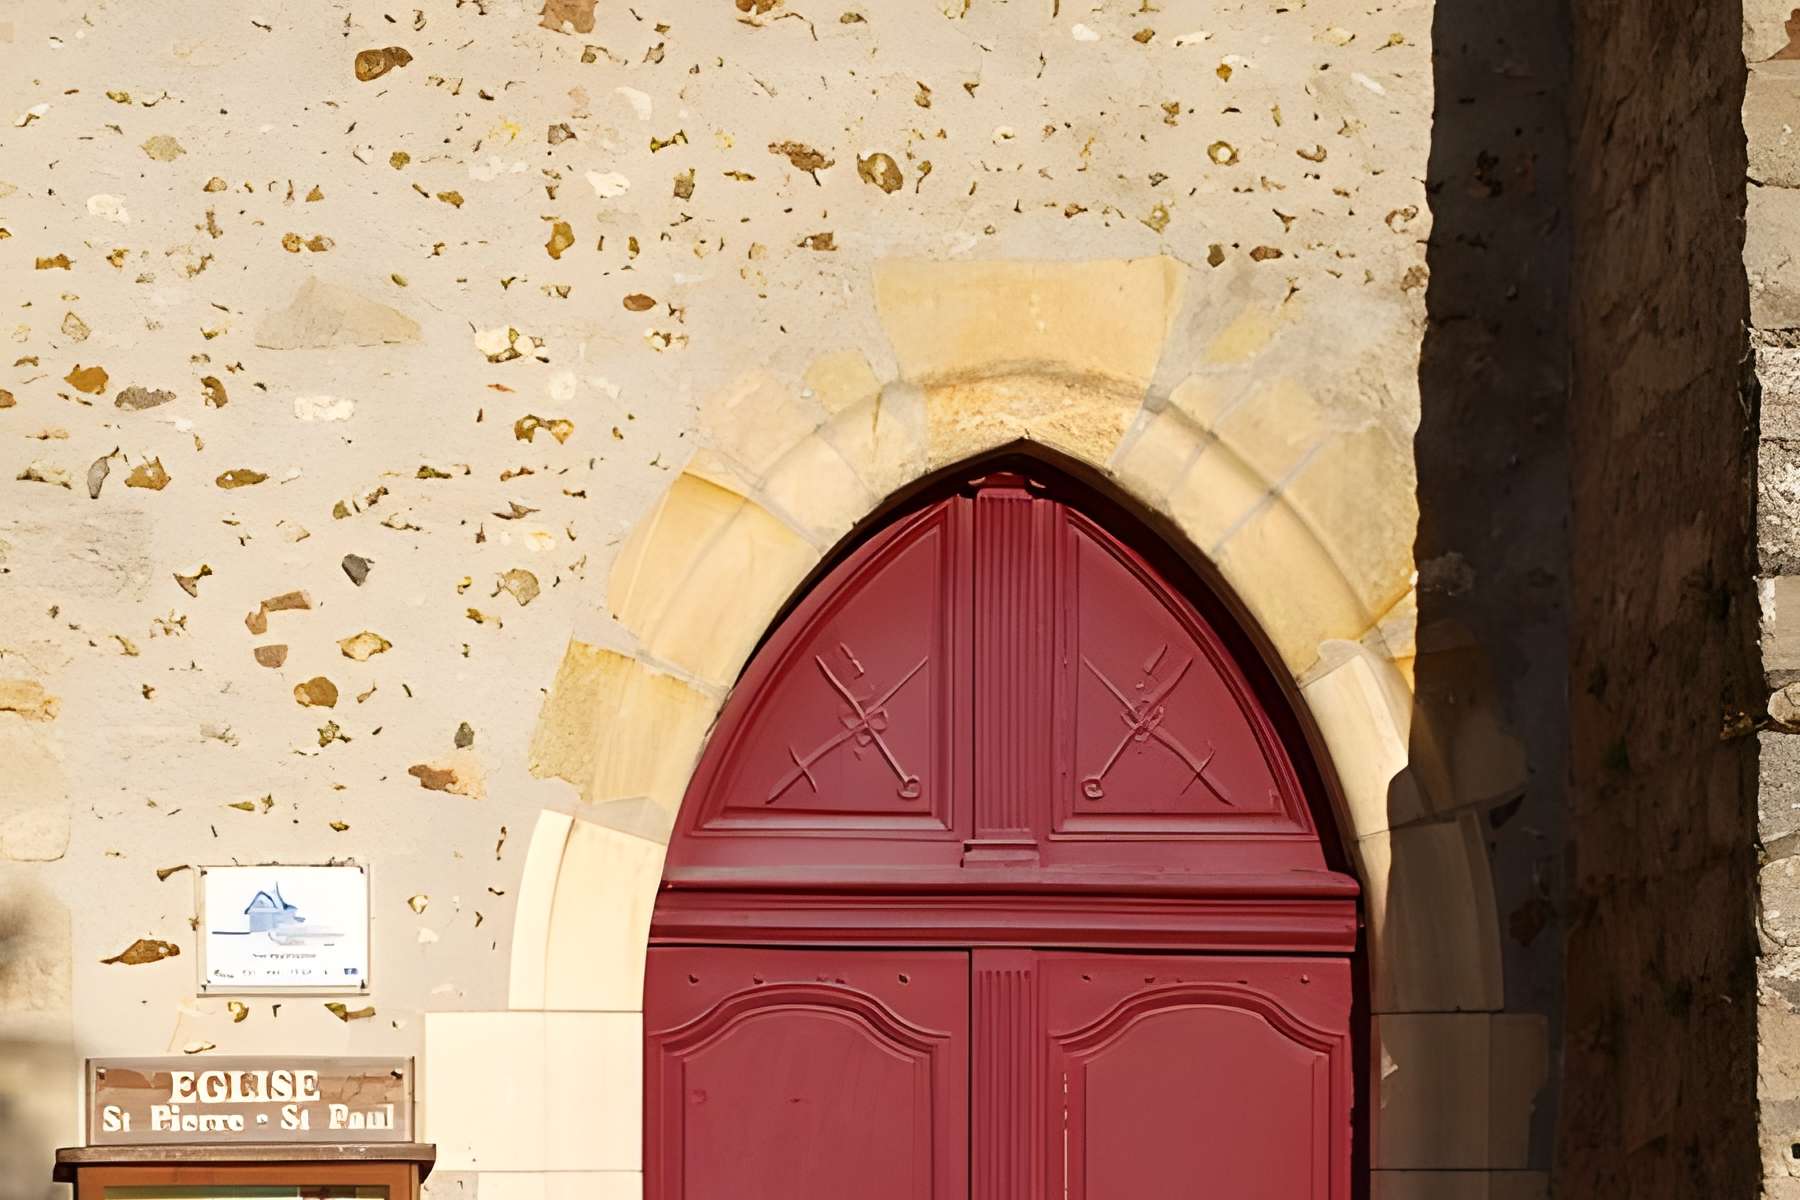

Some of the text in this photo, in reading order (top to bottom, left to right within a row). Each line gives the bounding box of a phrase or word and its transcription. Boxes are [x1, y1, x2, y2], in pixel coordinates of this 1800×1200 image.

[168, 1070, 321, 1103] EGLISE
[102, 1104, 130, 1132] St
[150, 1104, 244, 1132] Pierre
[280, 1103, 310, 1131] St
[328, 1103, 395, 1130] Paul
